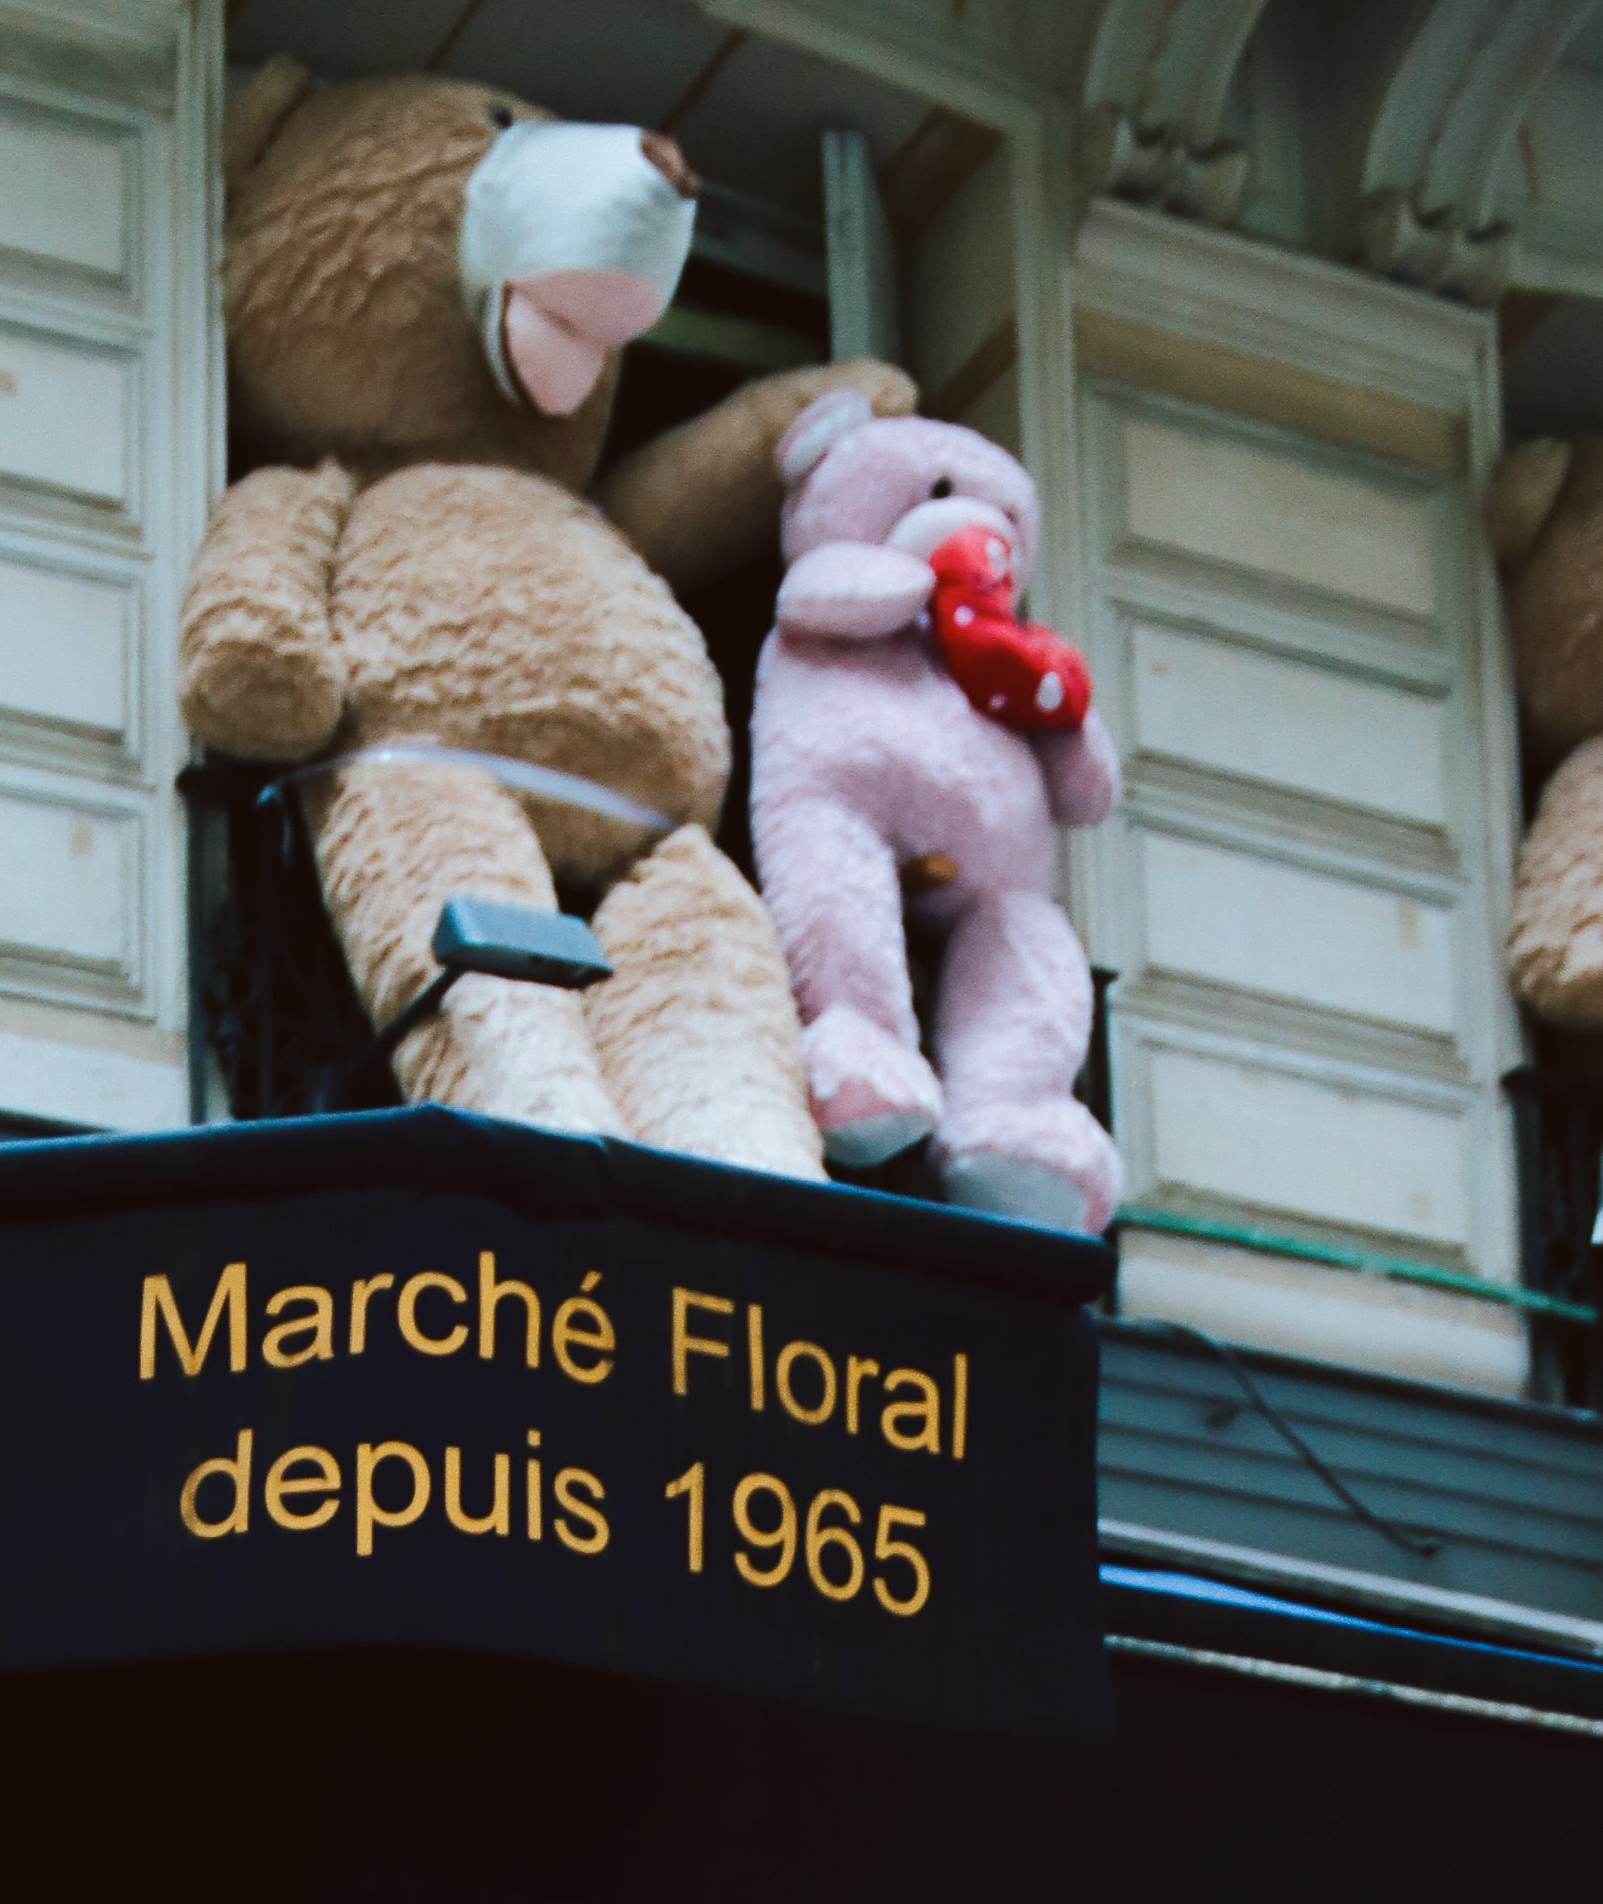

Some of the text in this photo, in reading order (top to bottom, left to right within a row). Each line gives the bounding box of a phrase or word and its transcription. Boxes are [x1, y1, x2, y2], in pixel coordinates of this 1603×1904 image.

[139, 1251, 969, 1459] Marché Floral
[180, 1429, 931, 1616] depuis 1965
